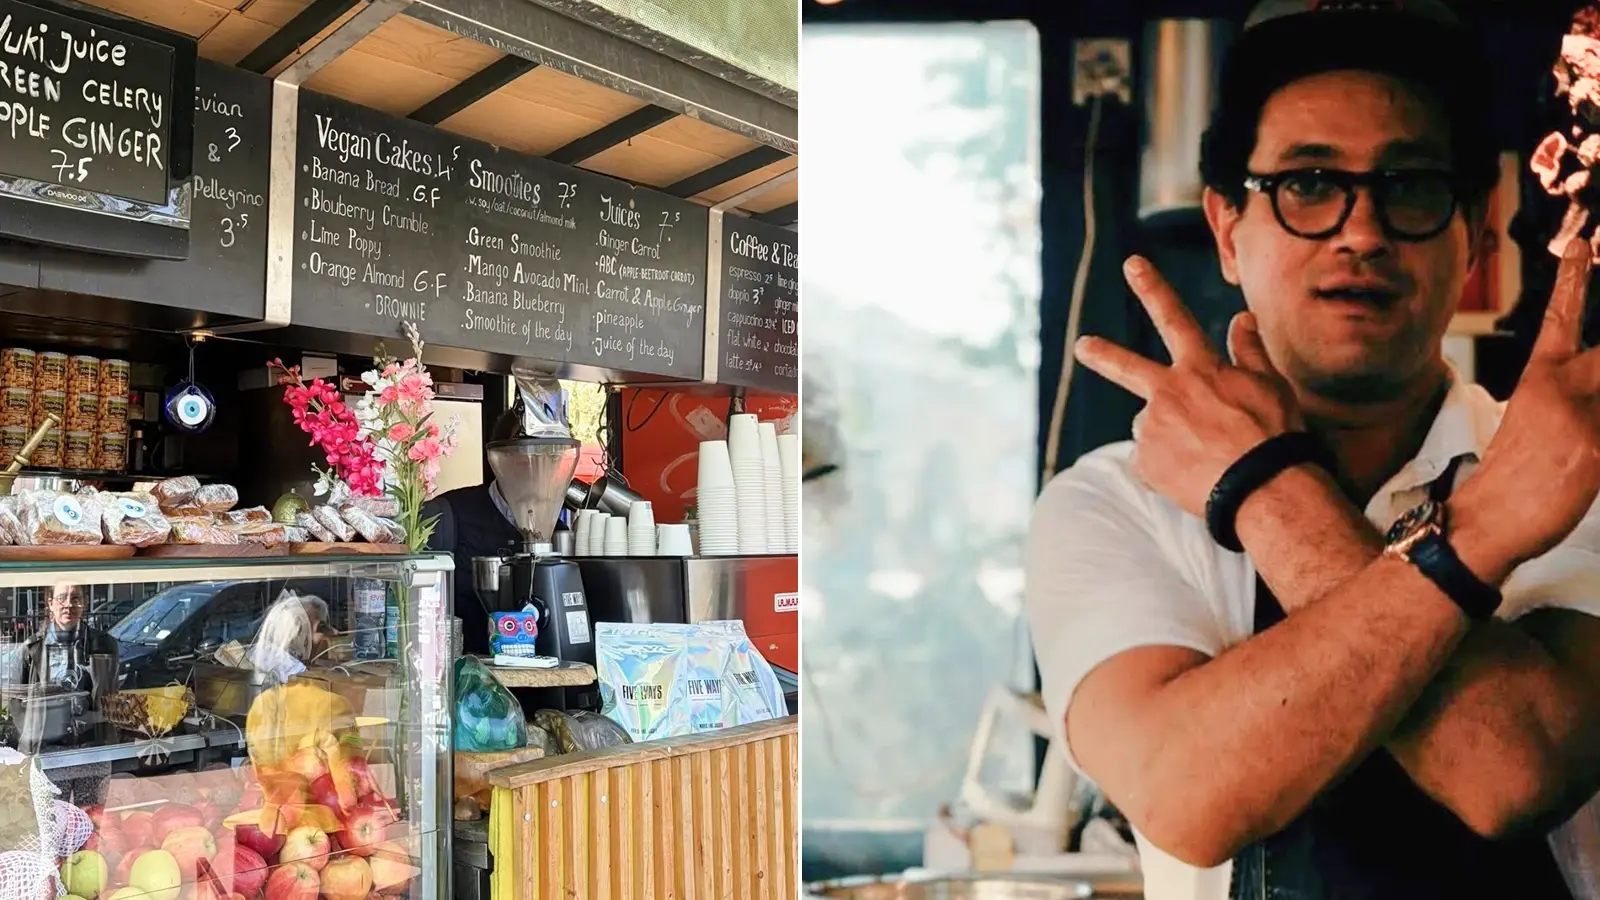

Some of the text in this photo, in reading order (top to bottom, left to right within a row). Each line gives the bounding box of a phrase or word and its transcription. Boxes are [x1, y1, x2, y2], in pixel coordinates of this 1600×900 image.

[49, 28, 127, 74] Juice
[82, 79, 162, 128] CELERY
[62, 117, 164, 170] GINGER
[208, 143, 221, 162] &
[225, 127, 241, 152] 3
[314, 114, 371, 164] Vegan
[51, 149, 93, 182] 7.5
[312, 156, 360, 188] Banana
[366, 169, 400, 198] Bread
[193, 175, 264, 210] Pellegrino
[311, 187, 429, 234] Blouberry Crumble
[600, 193, 641, 230] Juices
[310, 220, 382, 260] Lime Poppy
[468, 226, 561, 261] Green Smoothie
[599, 229, 660, 260] Ginger Carrot
[730, 231, 769, 261] Coffee
[771, 242, 781, 265] &
[309, 252, 356, 286] Orange
[363, 262, 405, 289] Almond
[468, 254, 590, 295] Mango Avocado Mint
[599, 254, 617, 276] ABC
[728, 265, 762, 282] espresso
[375, 294, 426, 321] BROWNIE
[466, 281, 565, 324] Banana Blueberry
[596, 280, 629, 303] Carrot
[631, 287, 642, 305] &
[728, 283, 750, 305] doppio
[465, 308, 573, 352] Smoothie of the day
[727, 328, 741, 347] flat
[743, 332, 762, 350] white
[626, 337, 636, 361] of
[640, 338, 655, 356] the
[657, 339, 674, 367] day
[725, 351, 744, 370] latte
[688, 679, 704, 695] FIVE
